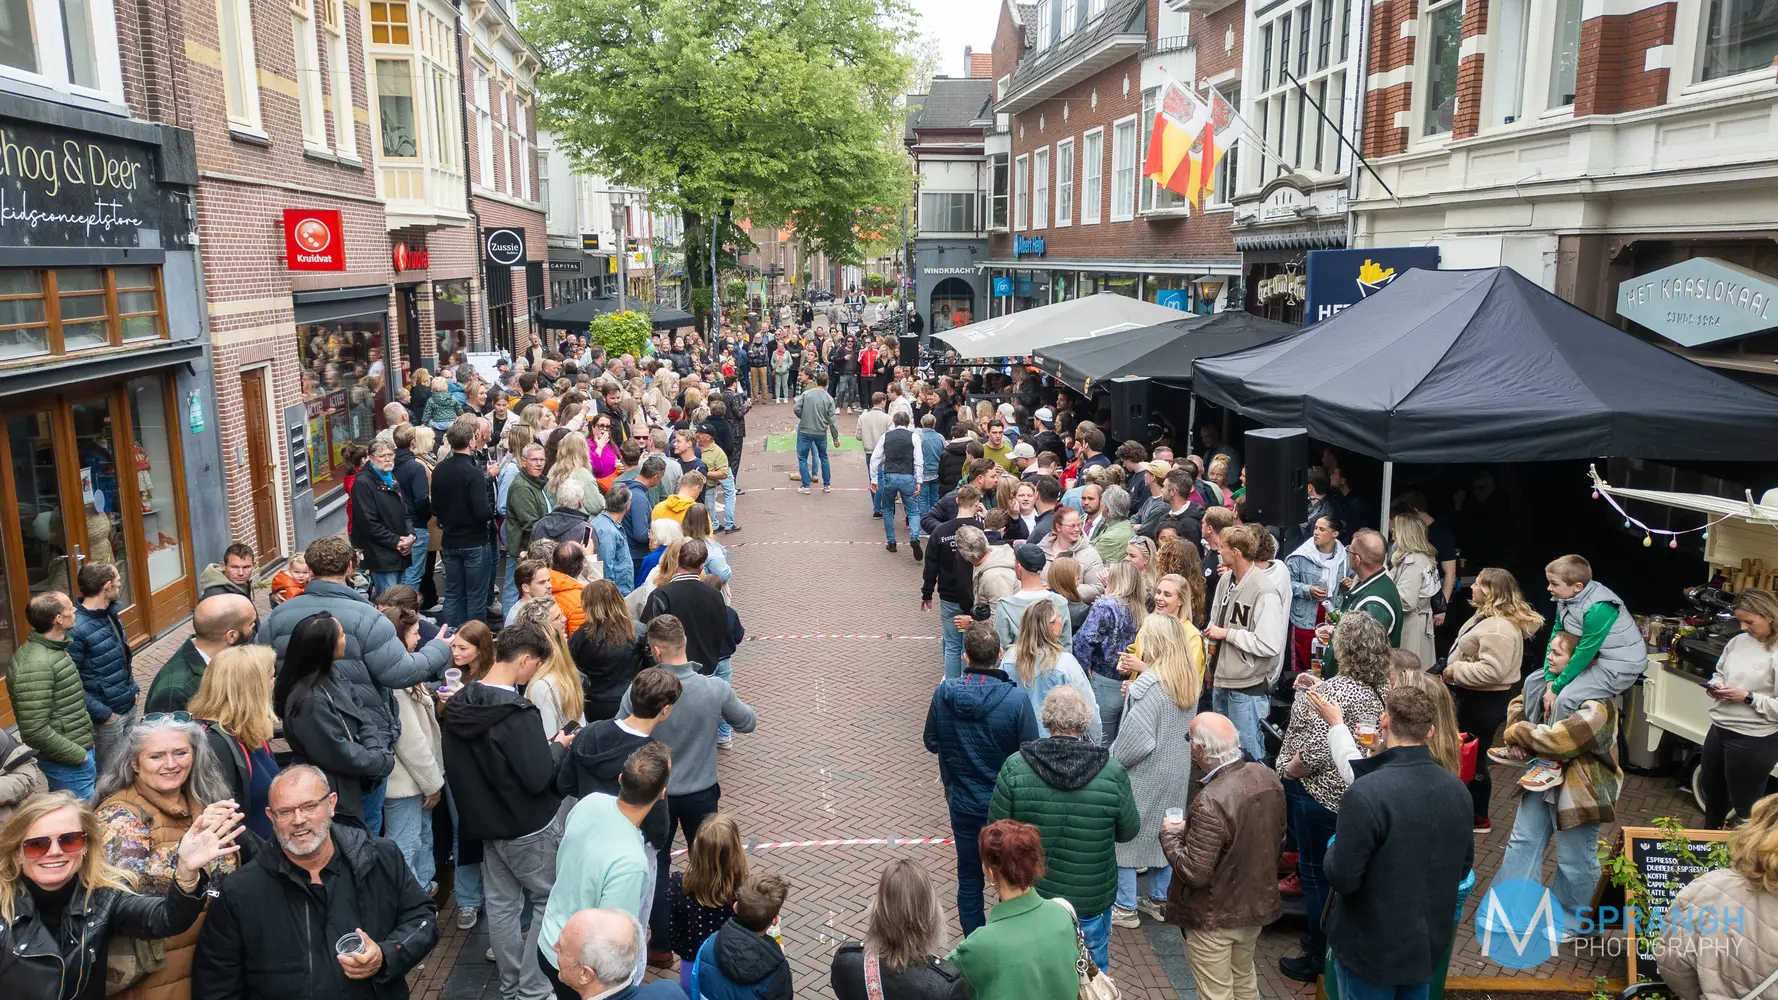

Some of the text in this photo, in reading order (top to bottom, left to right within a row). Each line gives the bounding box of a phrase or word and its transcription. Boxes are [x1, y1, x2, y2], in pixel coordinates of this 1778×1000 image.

[0, 129, 141, 197] hog & Deer
[1, 188, 143, 238] kidsconceptstore
[491, 242, 519, 252] Zussie
[297, 254, 333, 263] Kruidvat
[1625, 277, 1771, 321] HET KAASLOKAAL
[1666, 311, 1694, 325] SINDS
[1230, 600, 1252, 628] N
[1645, 856, 1678, 865] ESPRESSO
[1647, 872, 1668, 880] KOFFIE
